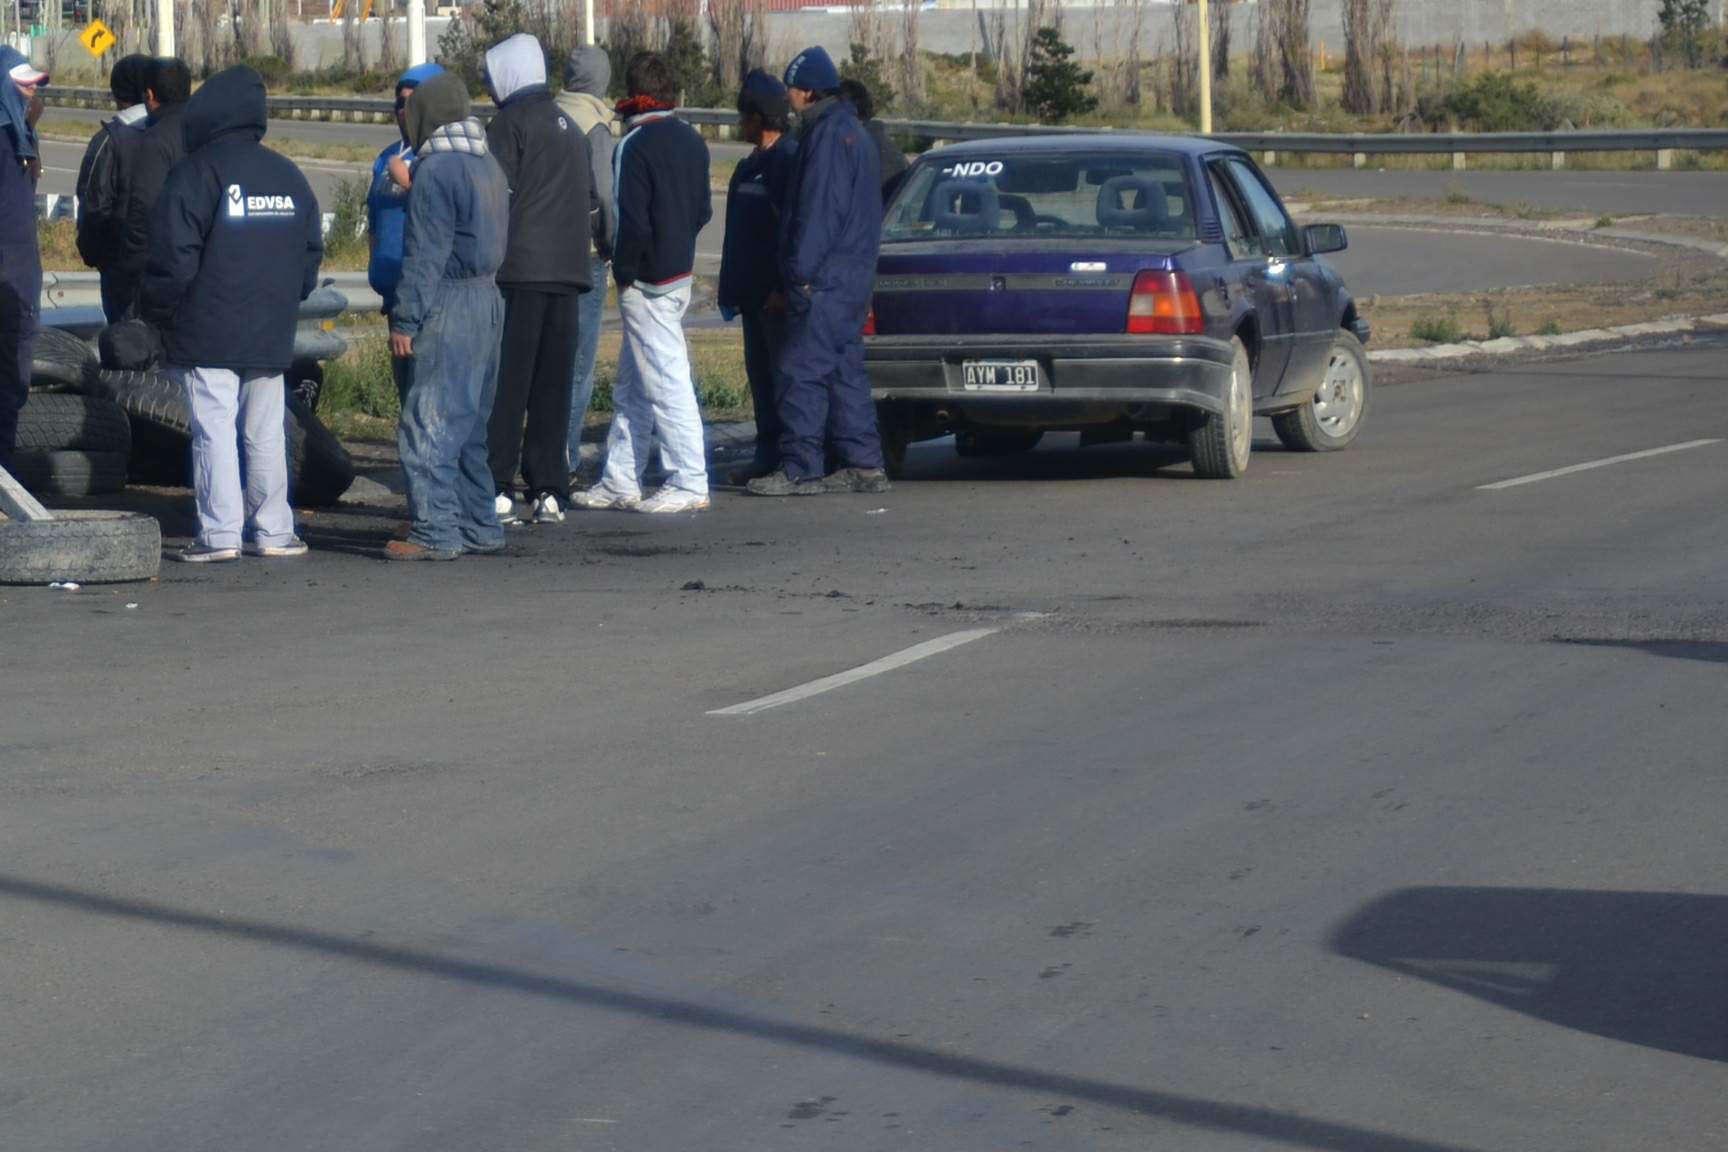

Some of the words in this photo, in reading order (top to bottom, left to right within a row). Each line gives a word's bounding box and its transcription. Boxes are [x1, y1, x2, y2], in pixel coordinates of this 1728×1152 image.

[247, 195, 295, 210] EDVSA
[967, 366, 996, 384] AYM
[1005, 366, 1035, 385] 181
